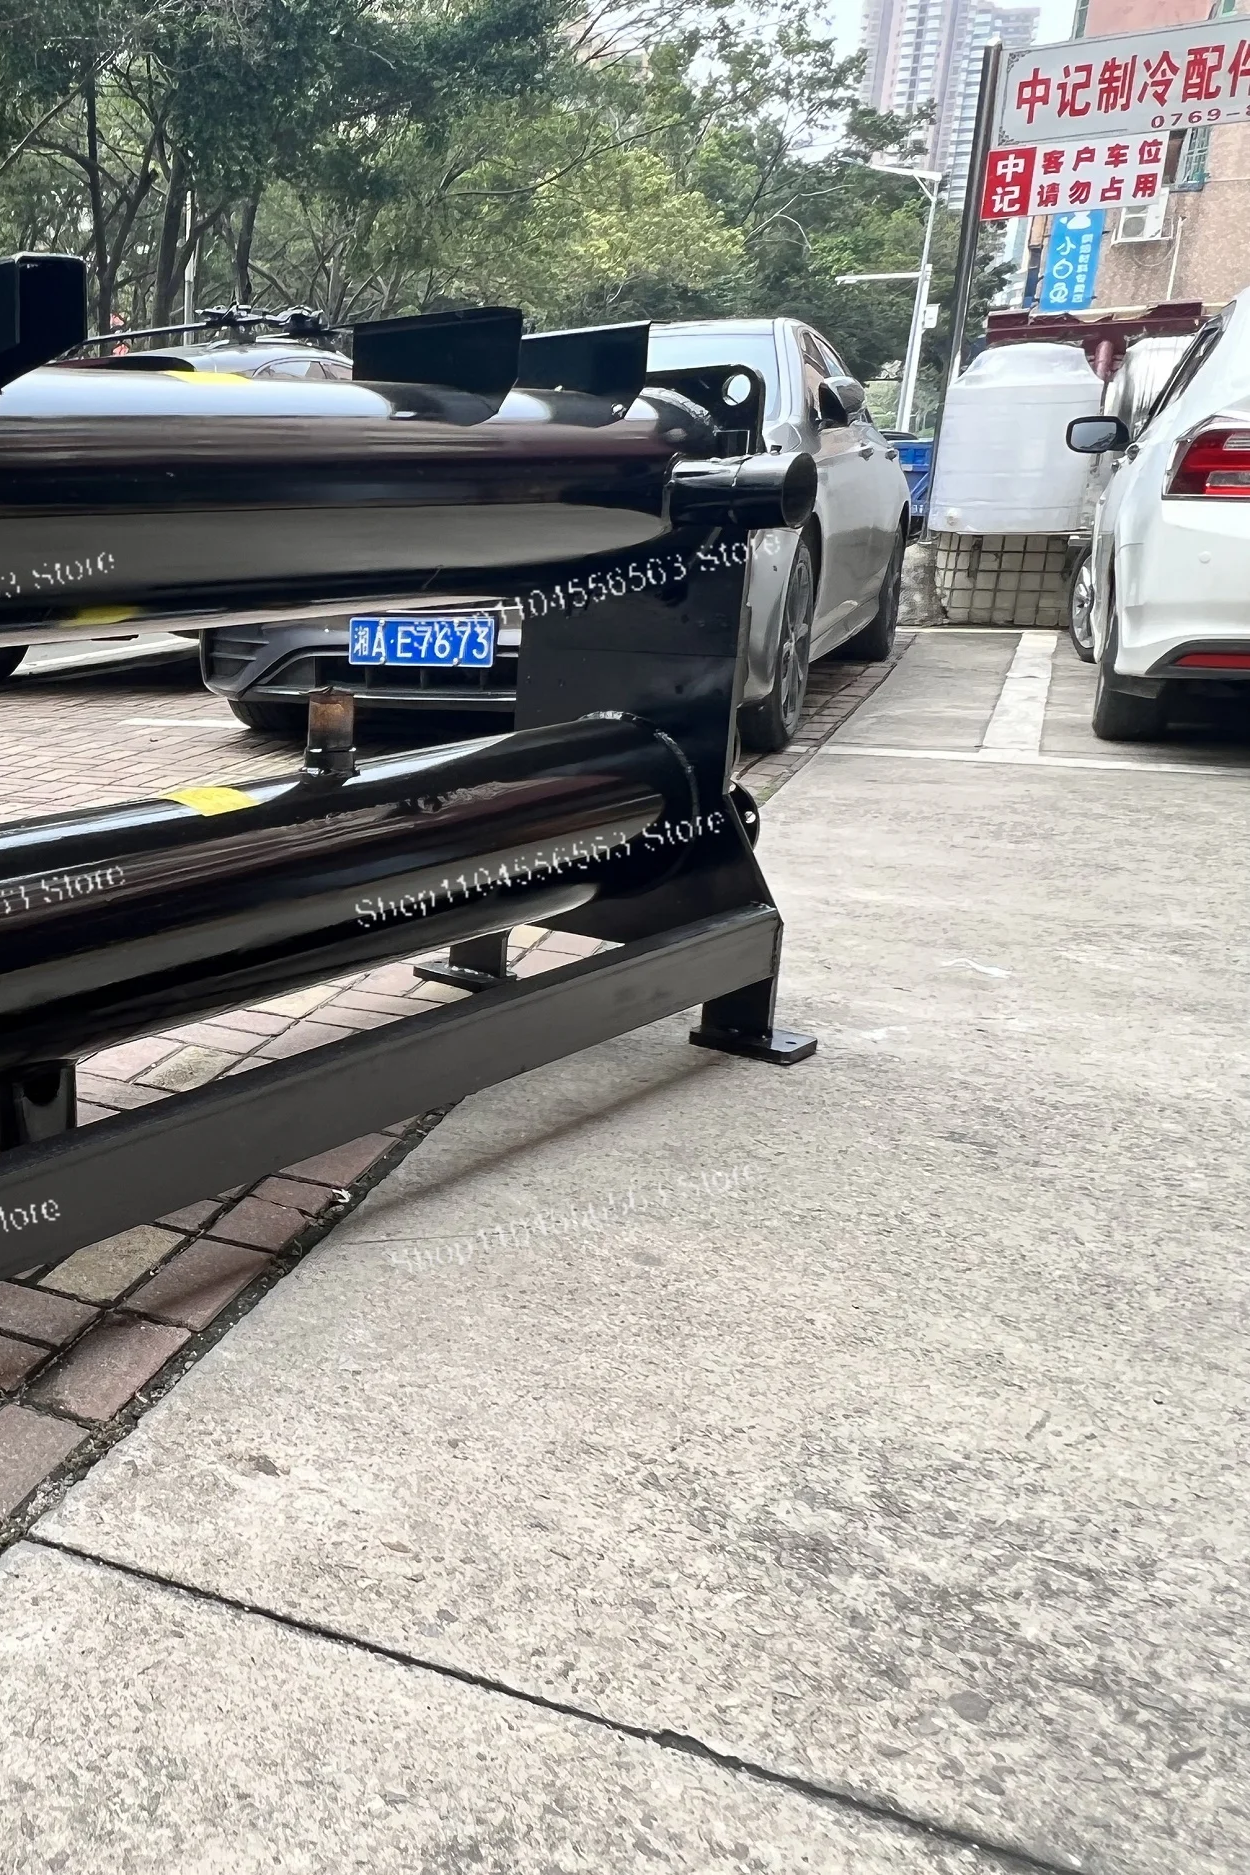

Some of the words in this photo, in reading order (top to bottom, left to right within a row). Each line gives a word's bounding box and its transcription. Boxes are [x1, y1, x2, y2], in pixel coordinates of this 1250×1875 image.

[1041, 138, 1163, 175] 客户车位
[992, 153, 1025, 214] 中记
[1036, 172, 1158, 208] 请勿占用
